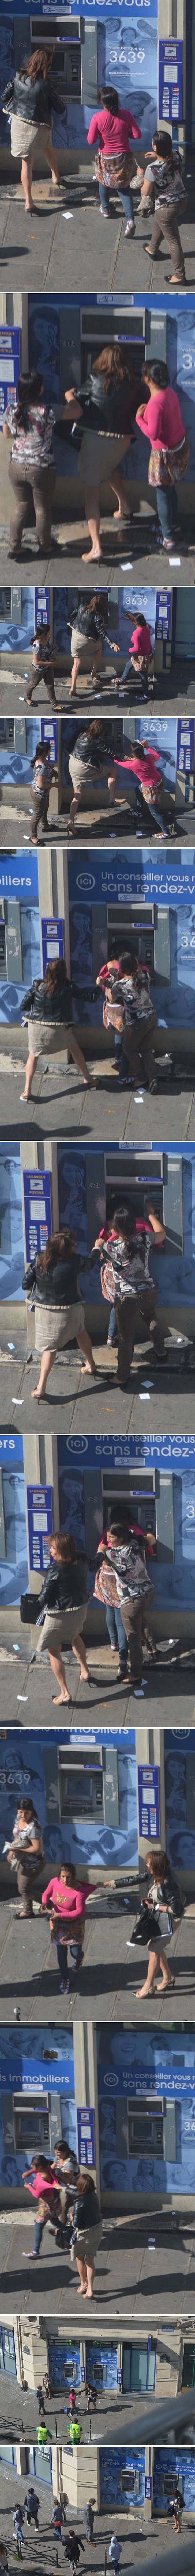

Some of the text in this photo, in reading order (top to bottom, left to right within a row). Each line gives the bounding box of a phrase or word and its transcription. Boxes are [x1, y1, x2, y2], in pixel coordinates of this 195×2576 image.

[109, 50, 145, 63] 3639
[182, 353, 195, 370] 3
[125, 597, 148, 605] 3639
[143, 723, 168, 732] 3639
[0, 875, 31, 886] iliers
[101, 872, 114, 880] Un
[117, 873, 164, 881] conseiller
[102, 883, 195, 894] sans rendez-v
[181, 936, 195, 947] 36
[95, 1444, 195, 1457] sans rendez-
[0, 1773, 30, 1784] 3639
[9, 2074, 70, 2083] immobiliers
[35, 2450, 50, 2459] TÉLÉPHONEZ
